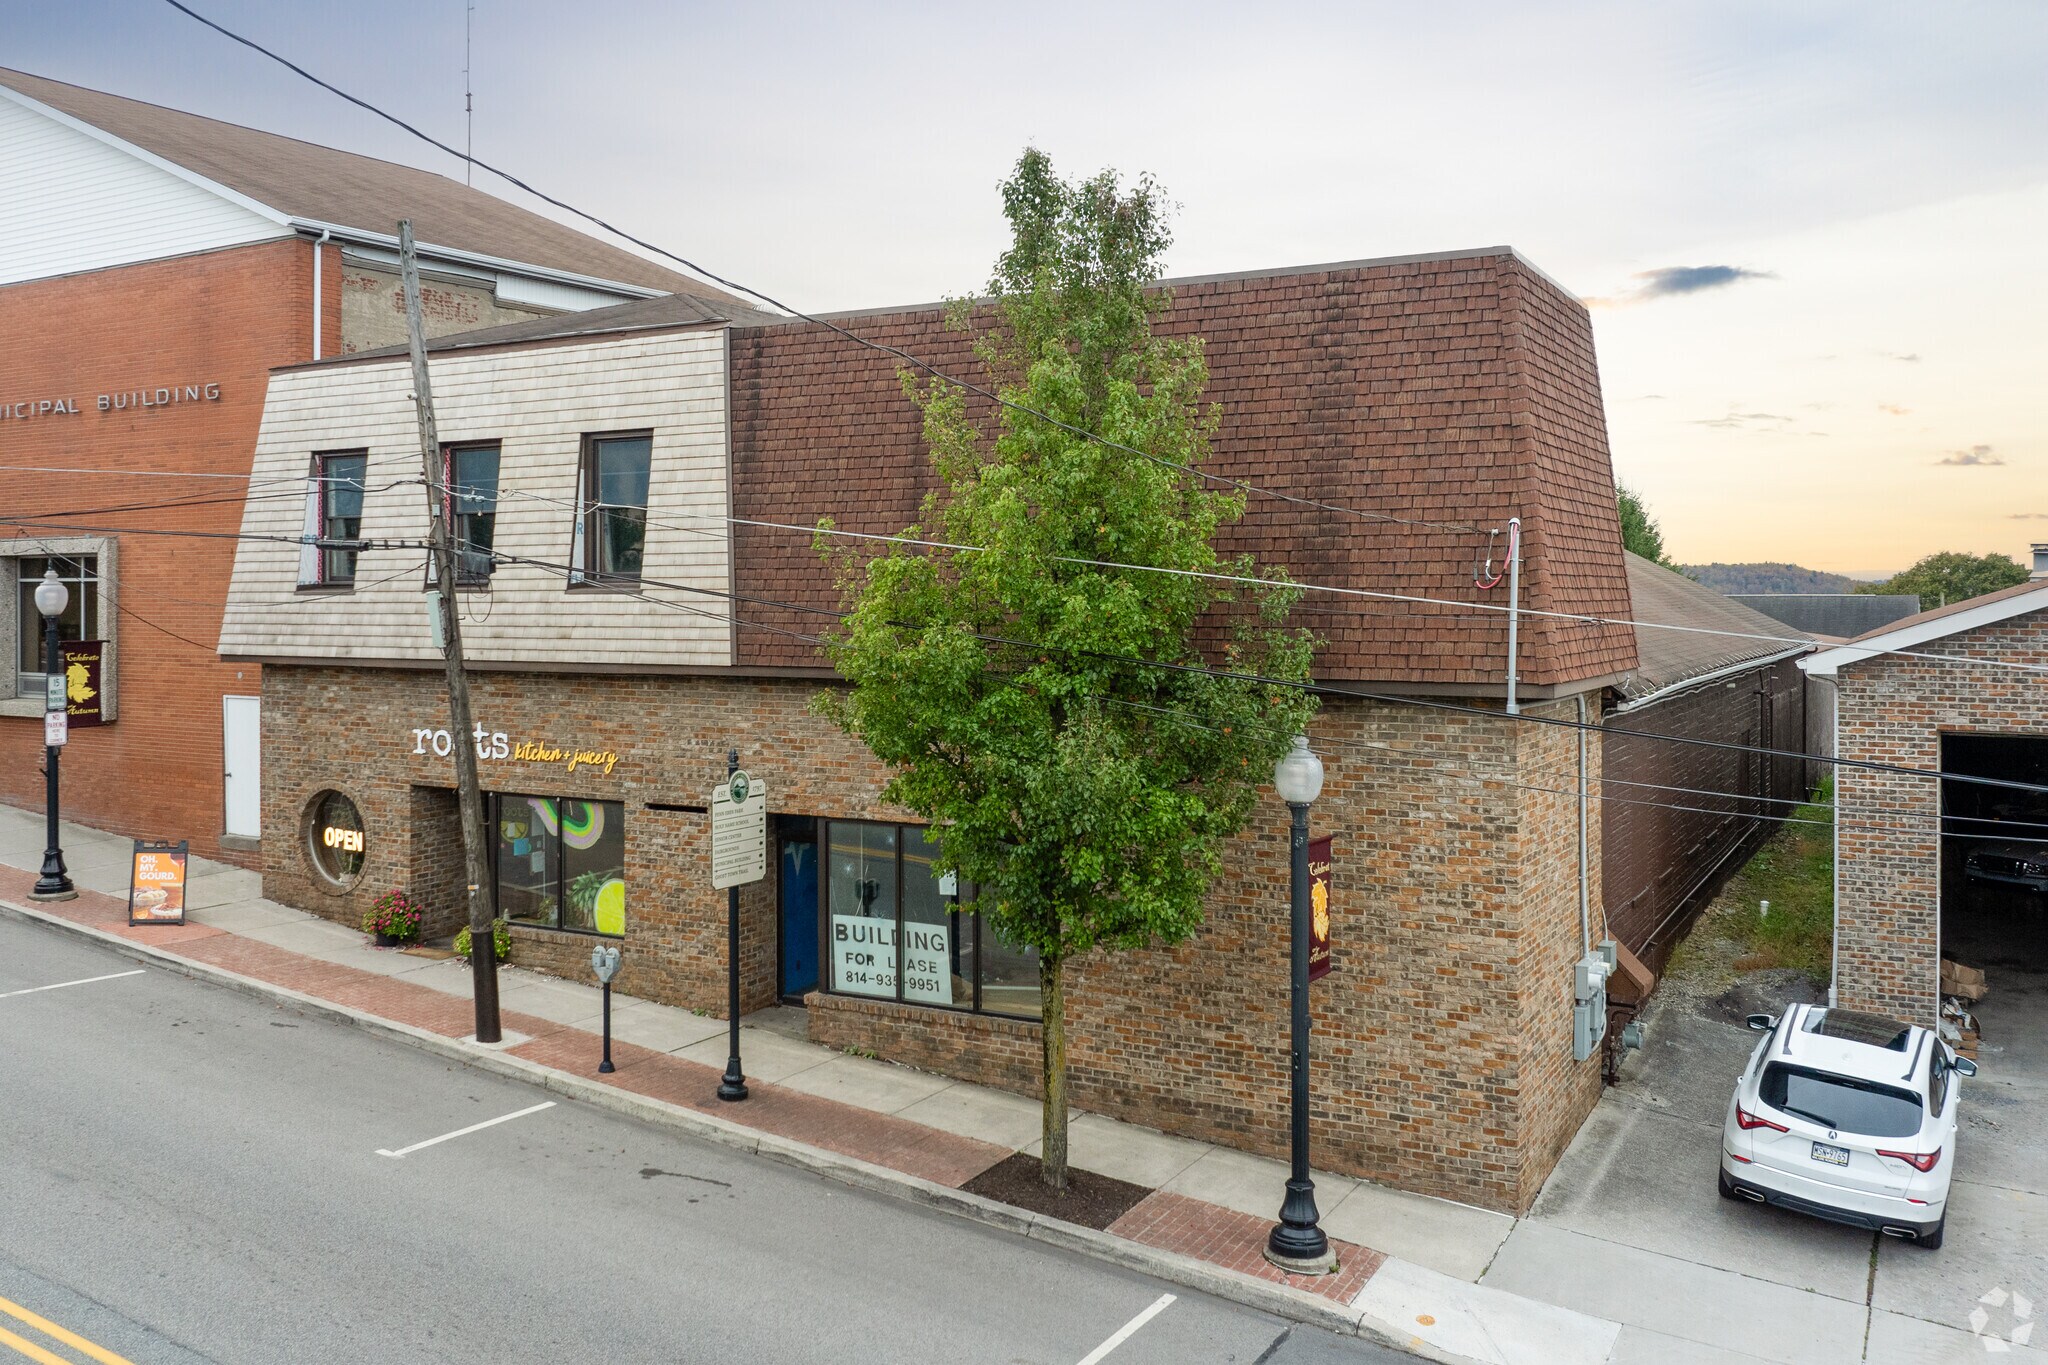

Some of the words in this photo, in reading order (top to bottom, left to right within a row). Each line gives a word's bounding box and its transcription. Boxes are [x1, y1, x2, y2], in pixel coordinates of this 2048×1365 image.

[0, 398, 80, 419] ICIPAL
[97, 383, 220, 411] BUILDING
[65, 652, 100, 662] Celebrate
[412, 721, 509, 759] rots
[514, 740, 563, 762] kitchen
[567, 747, 619, 774] juicery
[324, 826, 363, 852] OPEN
[139, 855, 158, 863] OH.
[139, 863, 158, 872] MY.
[139, 871, 177, 880] GOURD.
[845, 952, 875, 966] FOR
[887, 956, 938, 974] LASE
